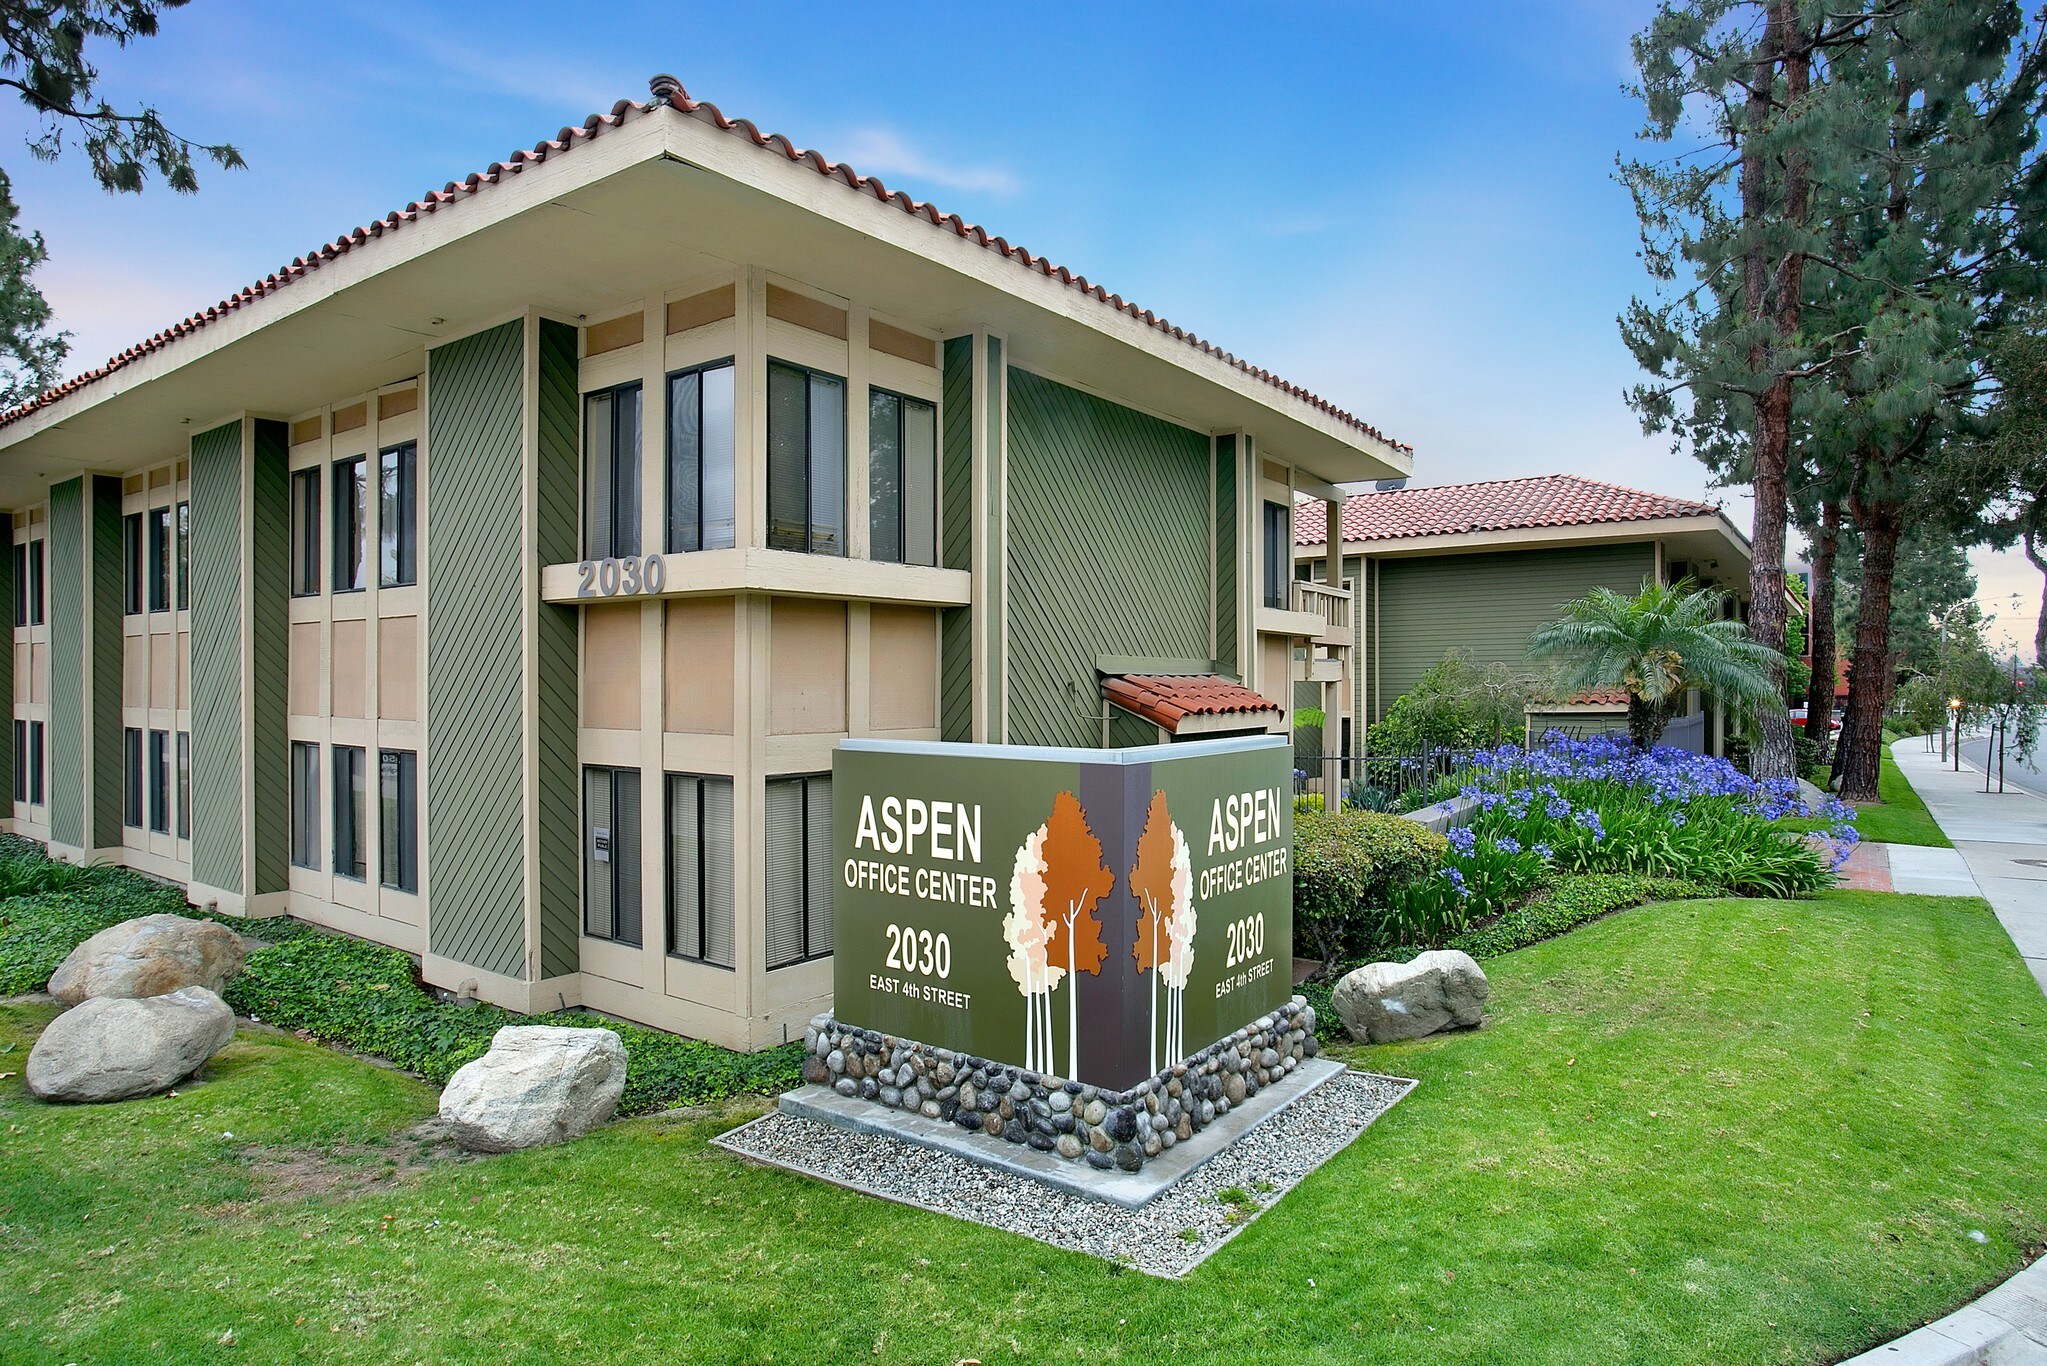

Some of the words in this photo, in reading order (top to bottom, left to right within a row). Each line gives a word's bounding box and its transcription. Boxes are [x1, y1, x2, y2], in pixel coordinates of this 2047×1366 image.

[577, 553, 666, 598] 2030
[854, 795, 981, 863] ASPEN
[1207, 786, 1281, 857] ASPEN
[844, 858, 910, 895] OFFICE
[915, 868, 998, 909] CENTER
[1200, 860, 1243, 901] OFFICE
[1245, 847, 1287, 886] CENTER
[885, 923, 951, 979] 2030
[1226, 911, 1264, 969] 2030
[869, 974, 900, 994] EAST
[902, 981, 920, 999] 4th
[922, 985, 971, 1010] STREET
[1216, 976, 1235, 999] EAST
[1236, 972, 1247, 988] 4th
[1248, 958, 1274, 983] STREET
